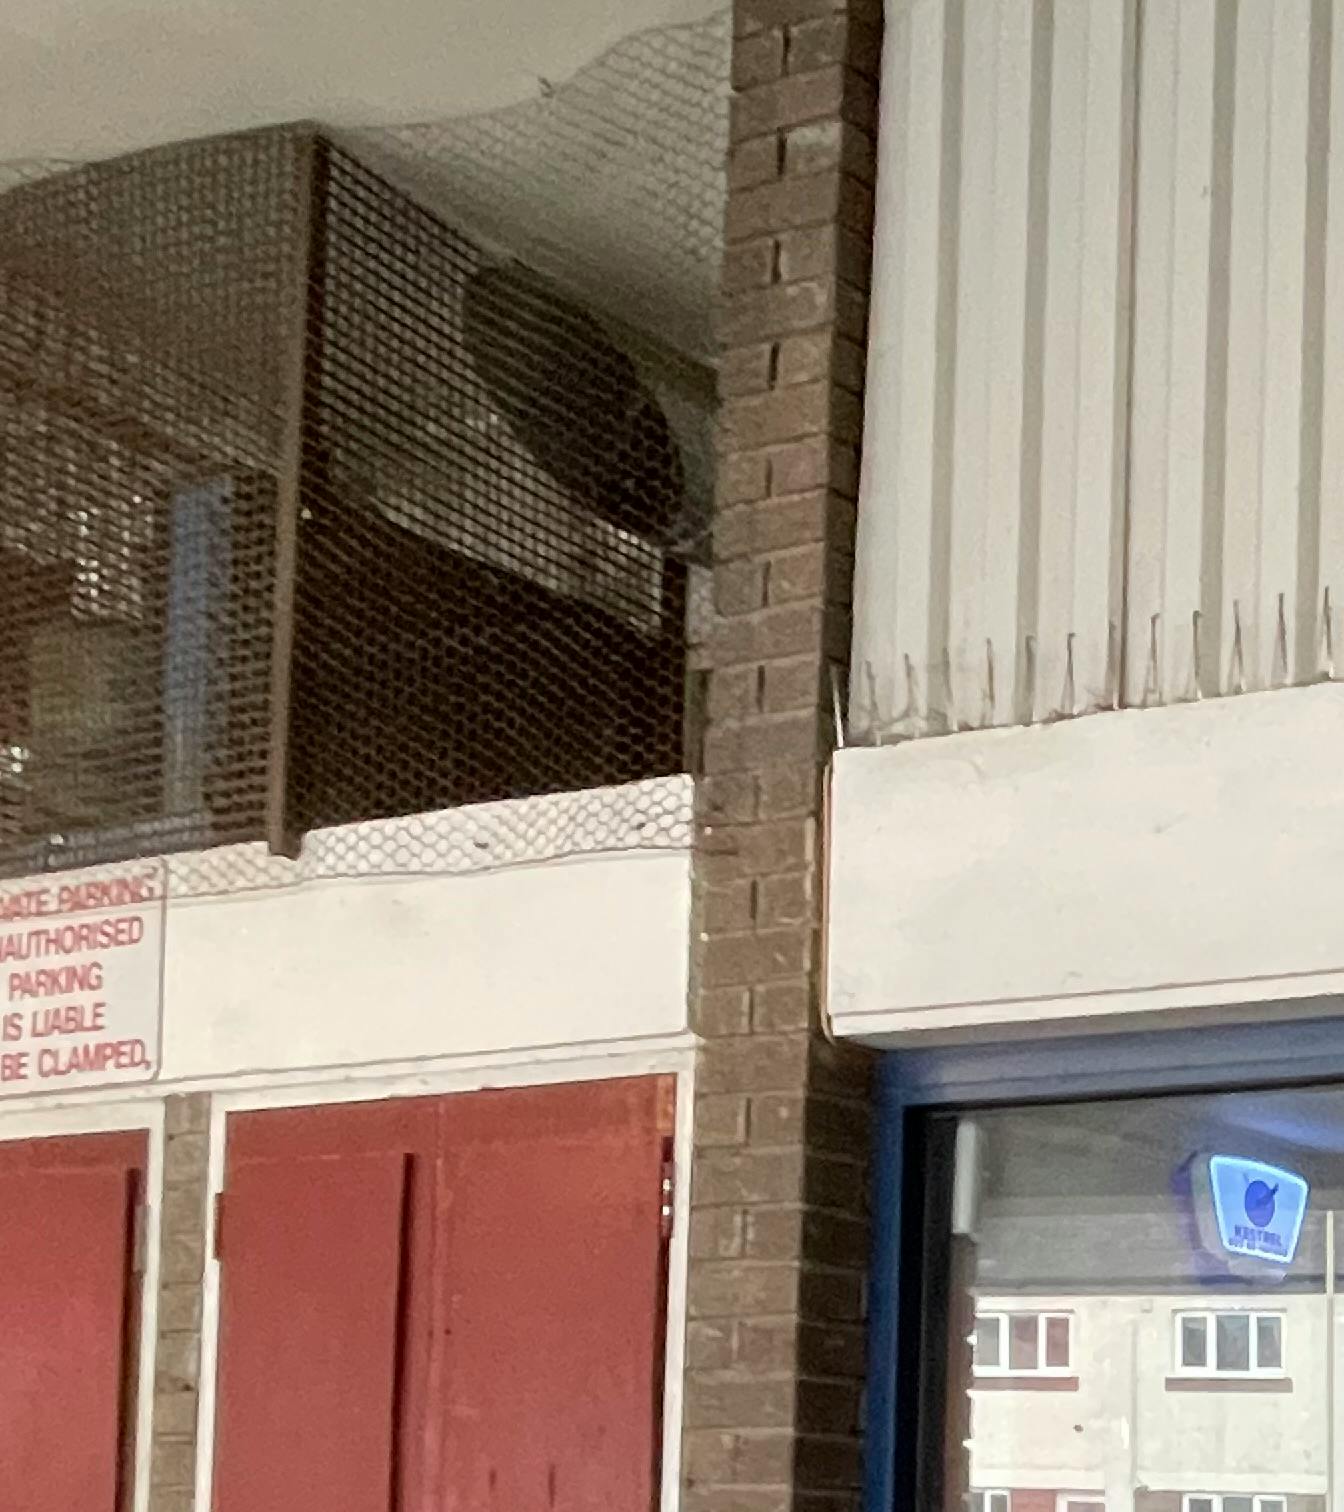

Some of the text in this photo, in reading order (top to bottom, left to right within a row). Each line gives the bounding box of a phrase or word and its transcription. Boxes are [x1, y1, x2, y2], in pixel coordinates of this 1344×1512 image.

[59, 868, 157, 913] PARKING
[9, 961, 104, 1001] PARKING
[3, 1002, 106, 1041] IS LIABLE
[1, 1051, 30, 1081] BE
